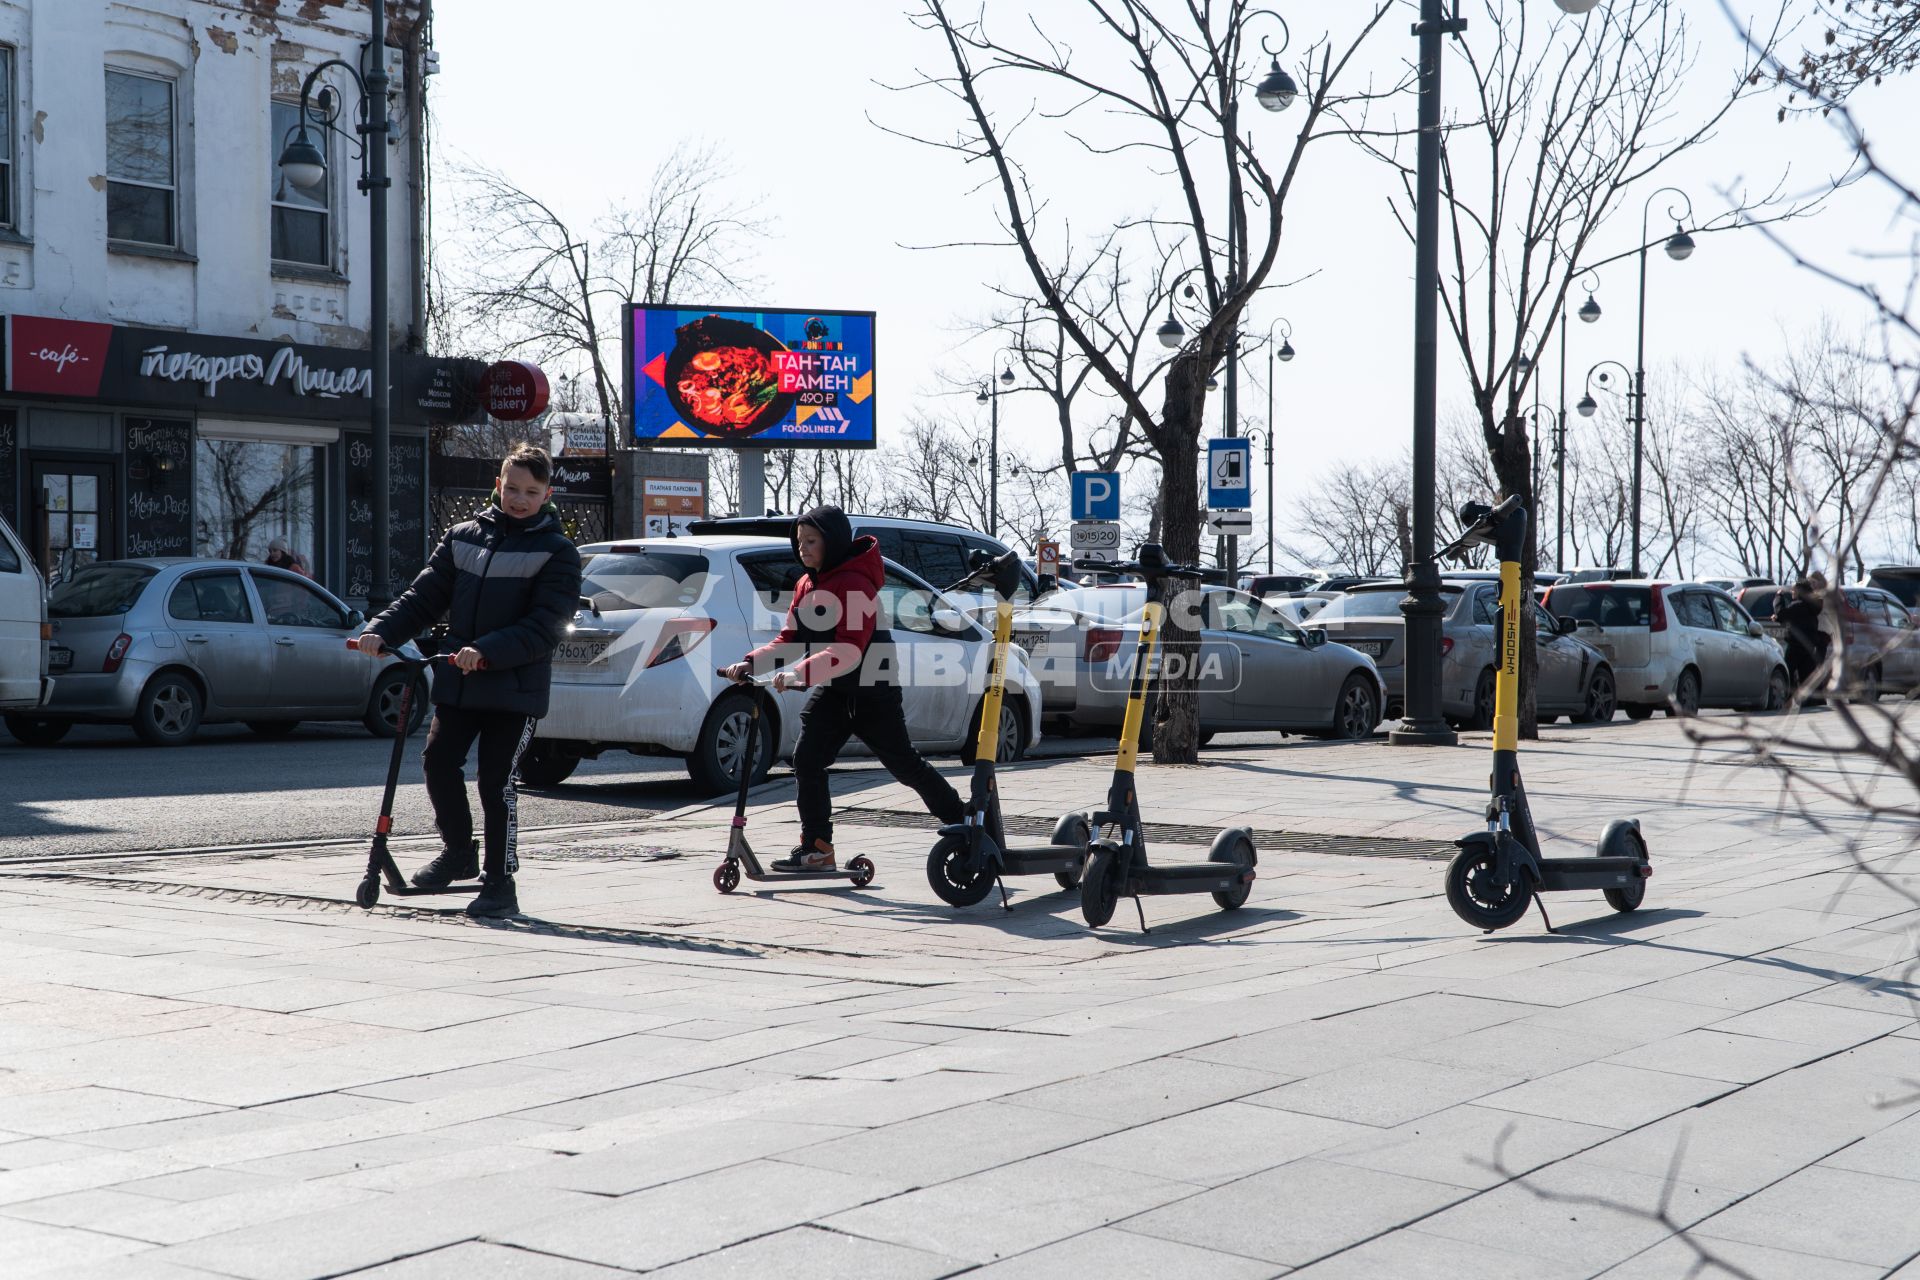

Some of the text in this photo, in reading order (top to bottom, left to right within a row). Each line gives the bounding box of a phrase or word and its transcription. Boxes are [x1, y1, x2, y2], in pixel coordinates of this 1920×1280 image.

[775, 354, 857, 372] ТАН-ТАН
[263, 347, 392, 399] Мишел
[433, 379, 451, 388] Toko
[784, 374, 849, 390] РАМЕН
[490, 383, 526, 397] Michel
[418, 398, 451, 409] Vladivostok
[491, 398, 528, 412] Bakery
[800, 392, 824, 404] 490
[782, 424, 836, 434] FOODLINER
[1507, 622, 1516, 675] WHOOSH
